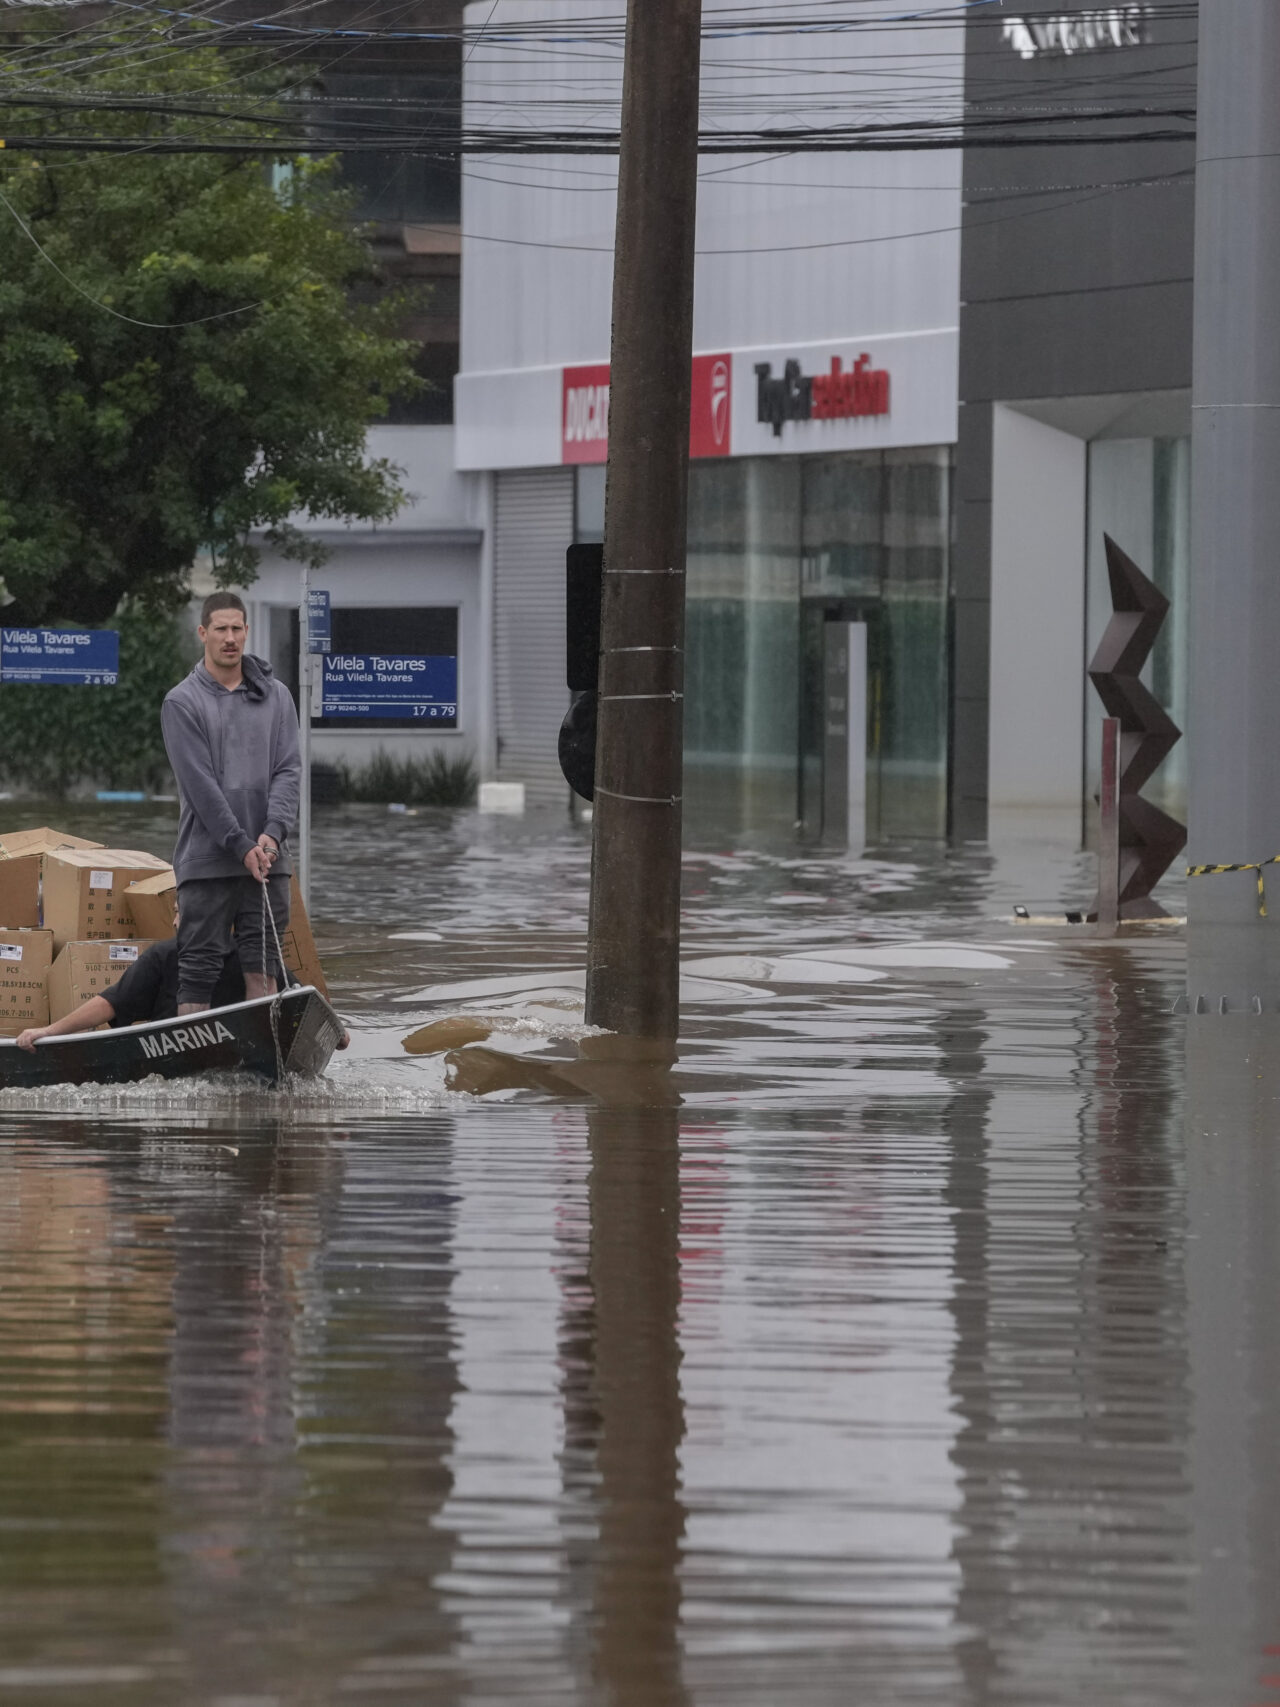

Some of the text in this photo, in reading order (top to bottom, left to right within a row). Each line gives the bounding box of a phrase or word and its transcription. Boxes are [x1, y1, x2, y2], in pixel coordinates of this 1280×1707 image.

[565, 385, 610, 442] DUCA
[3, 631, 91, 645] Vilela Tavares
[3, 645, 75, 654] Rua Vilela Tavares
[326, 656, 426, 671] Vilela Tavares
[84, 675, 91, 684] 2
[103, 675, 116, 685] 90
[325, 673, 413, 682] Rua Vilela Tavares
[413, 706, 456, 716] 17 a 79
[6, 966, 19, 974] PCS
[138, 1021, 236, 1059] MARINA
